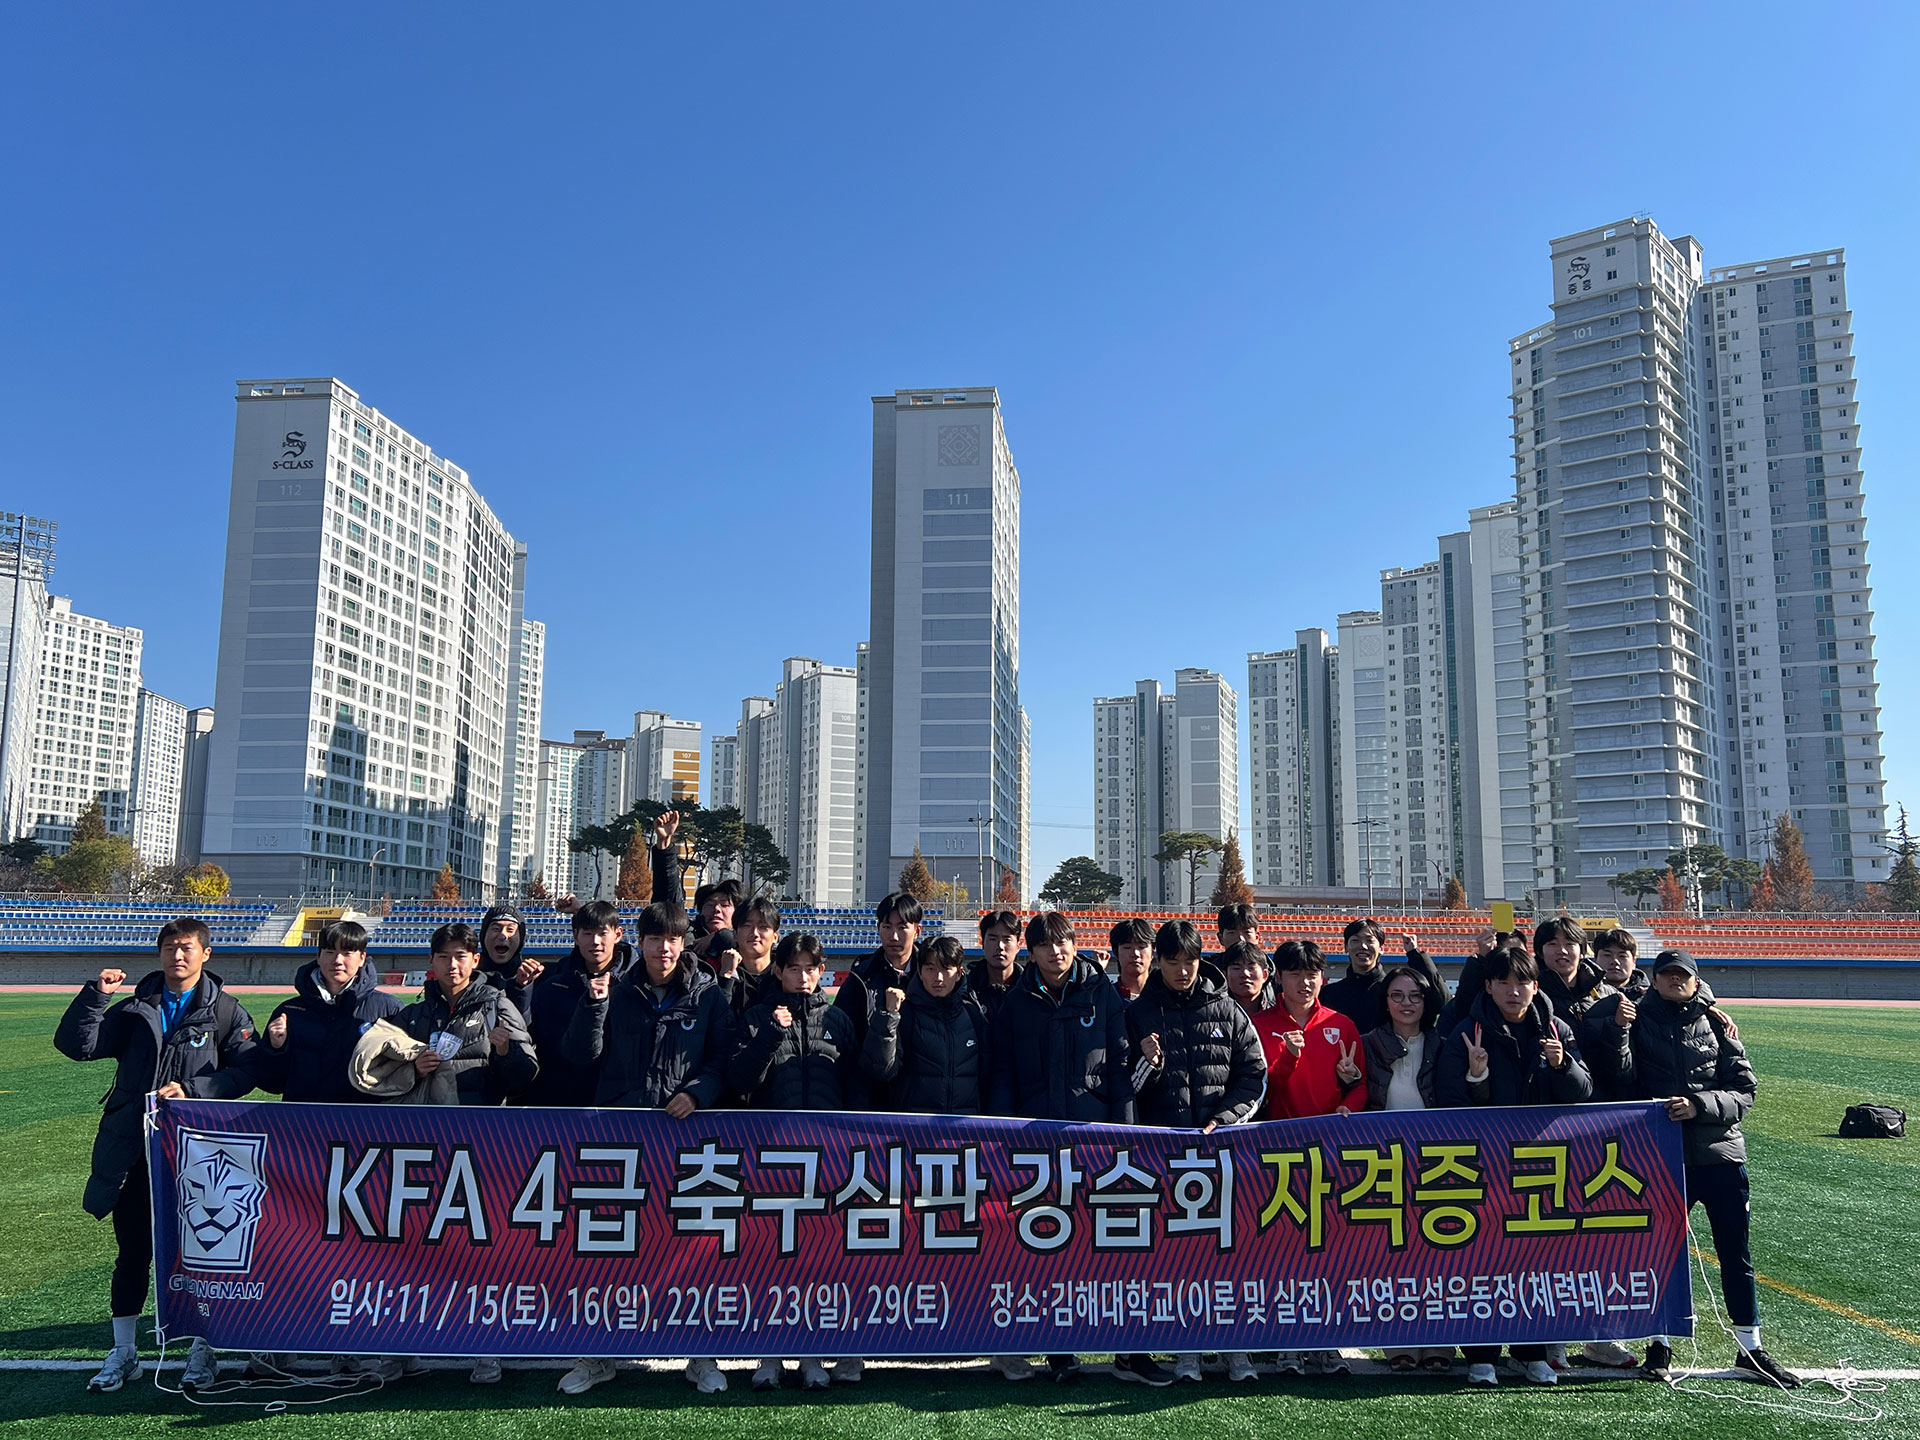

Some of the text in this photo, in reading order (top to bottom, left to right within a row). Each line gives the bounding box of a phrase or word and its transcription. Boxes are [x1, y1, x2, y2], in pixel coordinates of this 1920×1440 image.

[1572, 326, 1592, 340] 101
[272, 460, 314, 470] S-CLASS
[280, 485, 302, 496] 112
[947, 493, 969, 505] 111
[945, 839, 965, 849] 111
[1599, 856, 1617, 867] 101
[325, 1140, 1650, 1255] KFA 4급 축구심판 강습회 자격증 코스
[1242, 1278, 1267, 1325] 및
